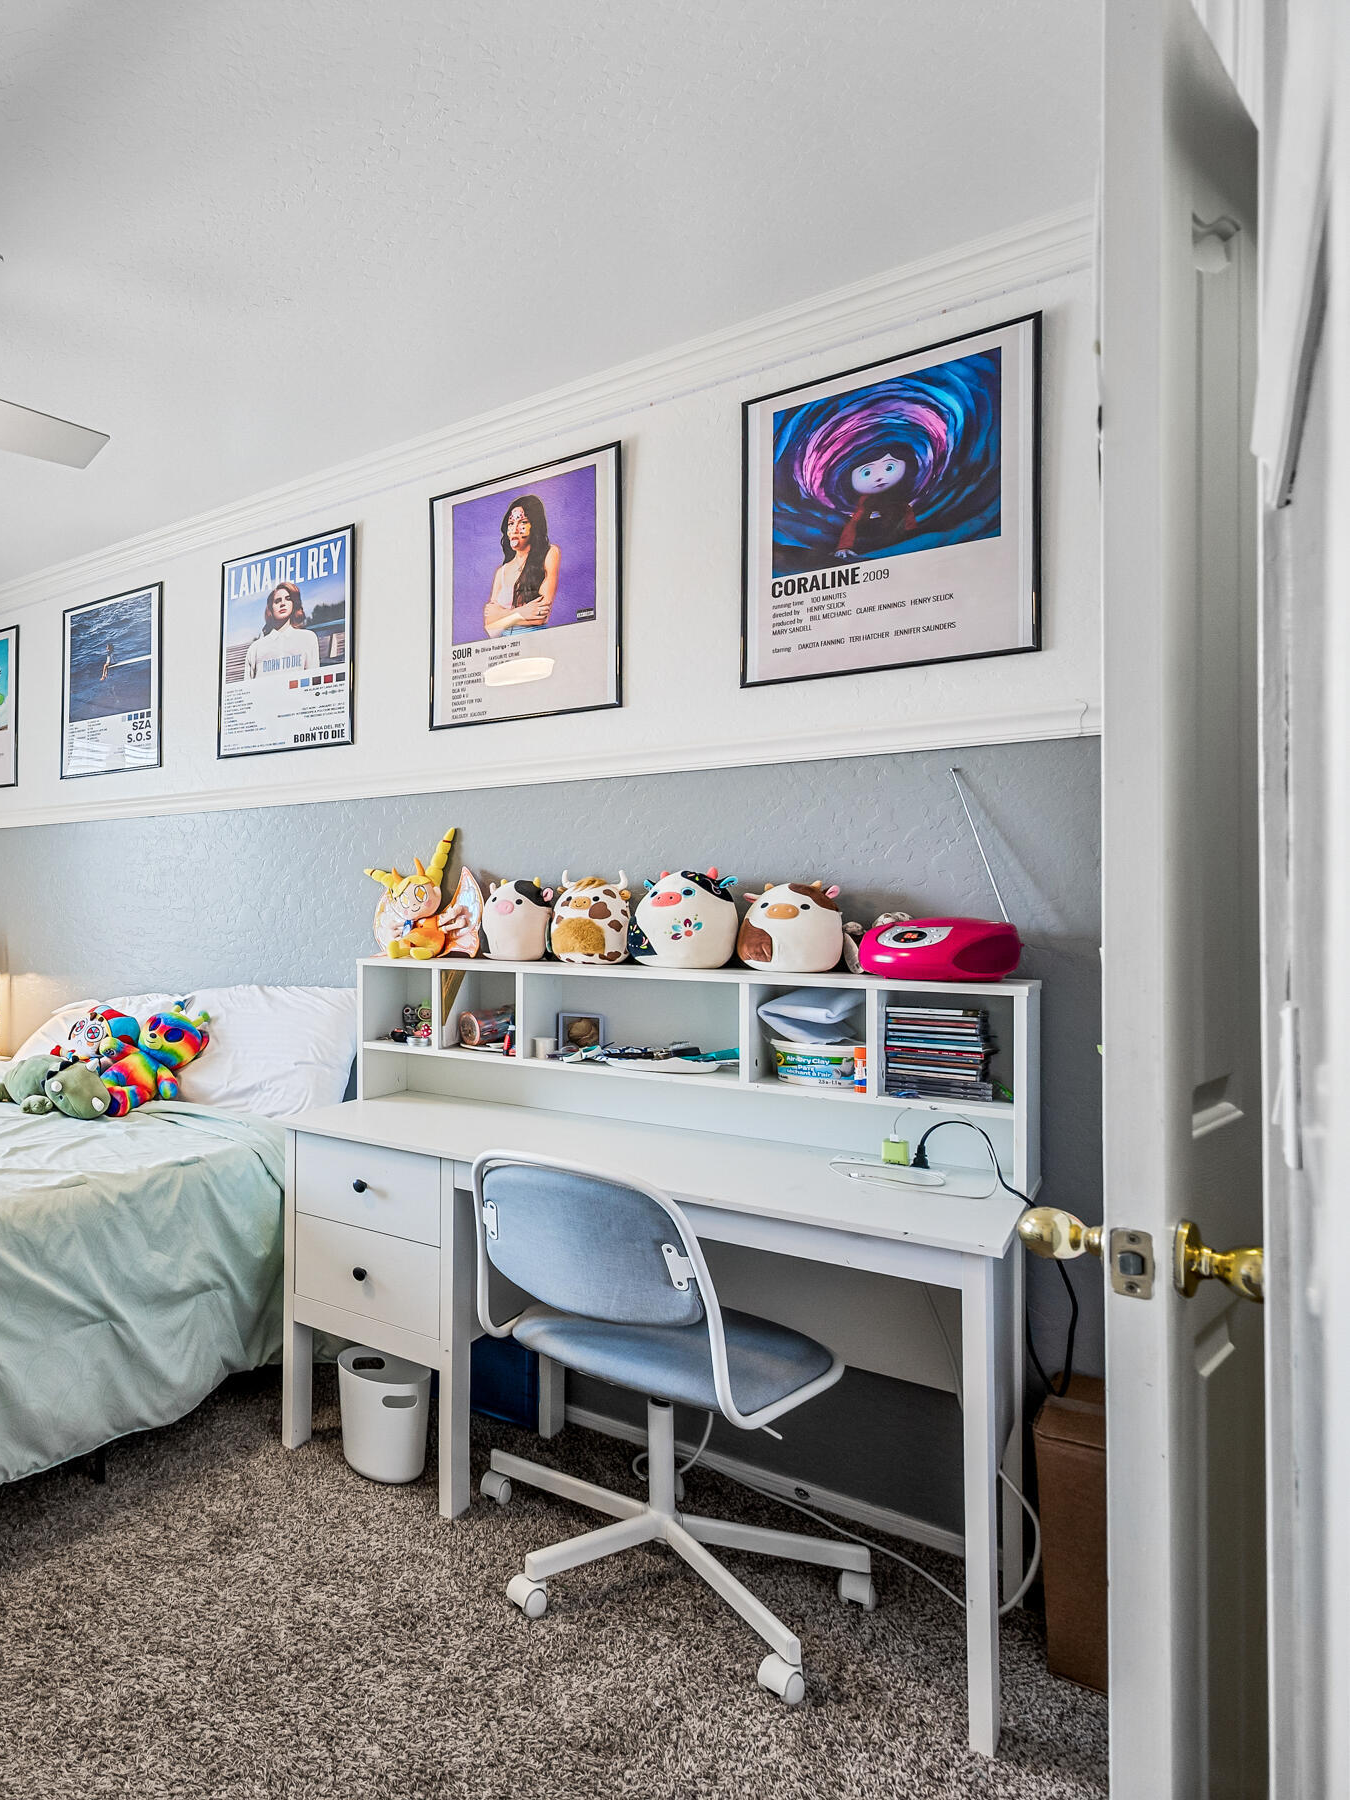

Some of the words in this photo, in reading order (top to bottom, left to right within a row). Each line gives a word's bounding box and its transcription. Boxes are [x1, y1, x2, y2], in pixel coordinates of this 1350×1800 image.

[230, 560, 272, 600] LANA
[274, 551, 304, 586] DEL
[308, 540, 342, 580] REY
[772, 567, 860, 598] CORALINE
[862, 568, 890, 582] 2009
[772, 602, 791, 610] running
[822, 592, 846, 602] MINUTES
[772, 610, 792, 618] directed
[807, 604, 825, 614] HENRY
[826, 602, 846, 610] SELICK
[772, 619, 795, 628] produced
[822, 610, 852, 620] MECHANIC
[856, 606, 875, 614] CLAIRE
[877, 601, 906, 611] JENNINGS
[910, 597, 930, 606] HENRY
[932, 593, 954, 602] SELICK
[772, 628, 788, 636] MARY
[788, 625, 812, 634] SANDELL
[798, 642, 820, 650] DAKOTA
[821, 638, 844, 646] FANNING
[862, 632, 889, 640] HATCHER
[894, 627, 920, 636] JENNIFER
[922, 622, 956, 632] SAUNDERS
[452, 648, 472, 660] SOUR
[263, 658, 280, 672] BORN
[282, 656, 290, 670] TO
[292, 654, 302, 668] DIE
[132, 720, 152, 730] SZA
[127, 731, 152, 742] S.O.S
[294, 732, 316, 743] BORN
[318, 730, 329, 740] TO
[331, 729, 345, 738] DIE
[786, 1056, 810, 1064] Air-Dry
